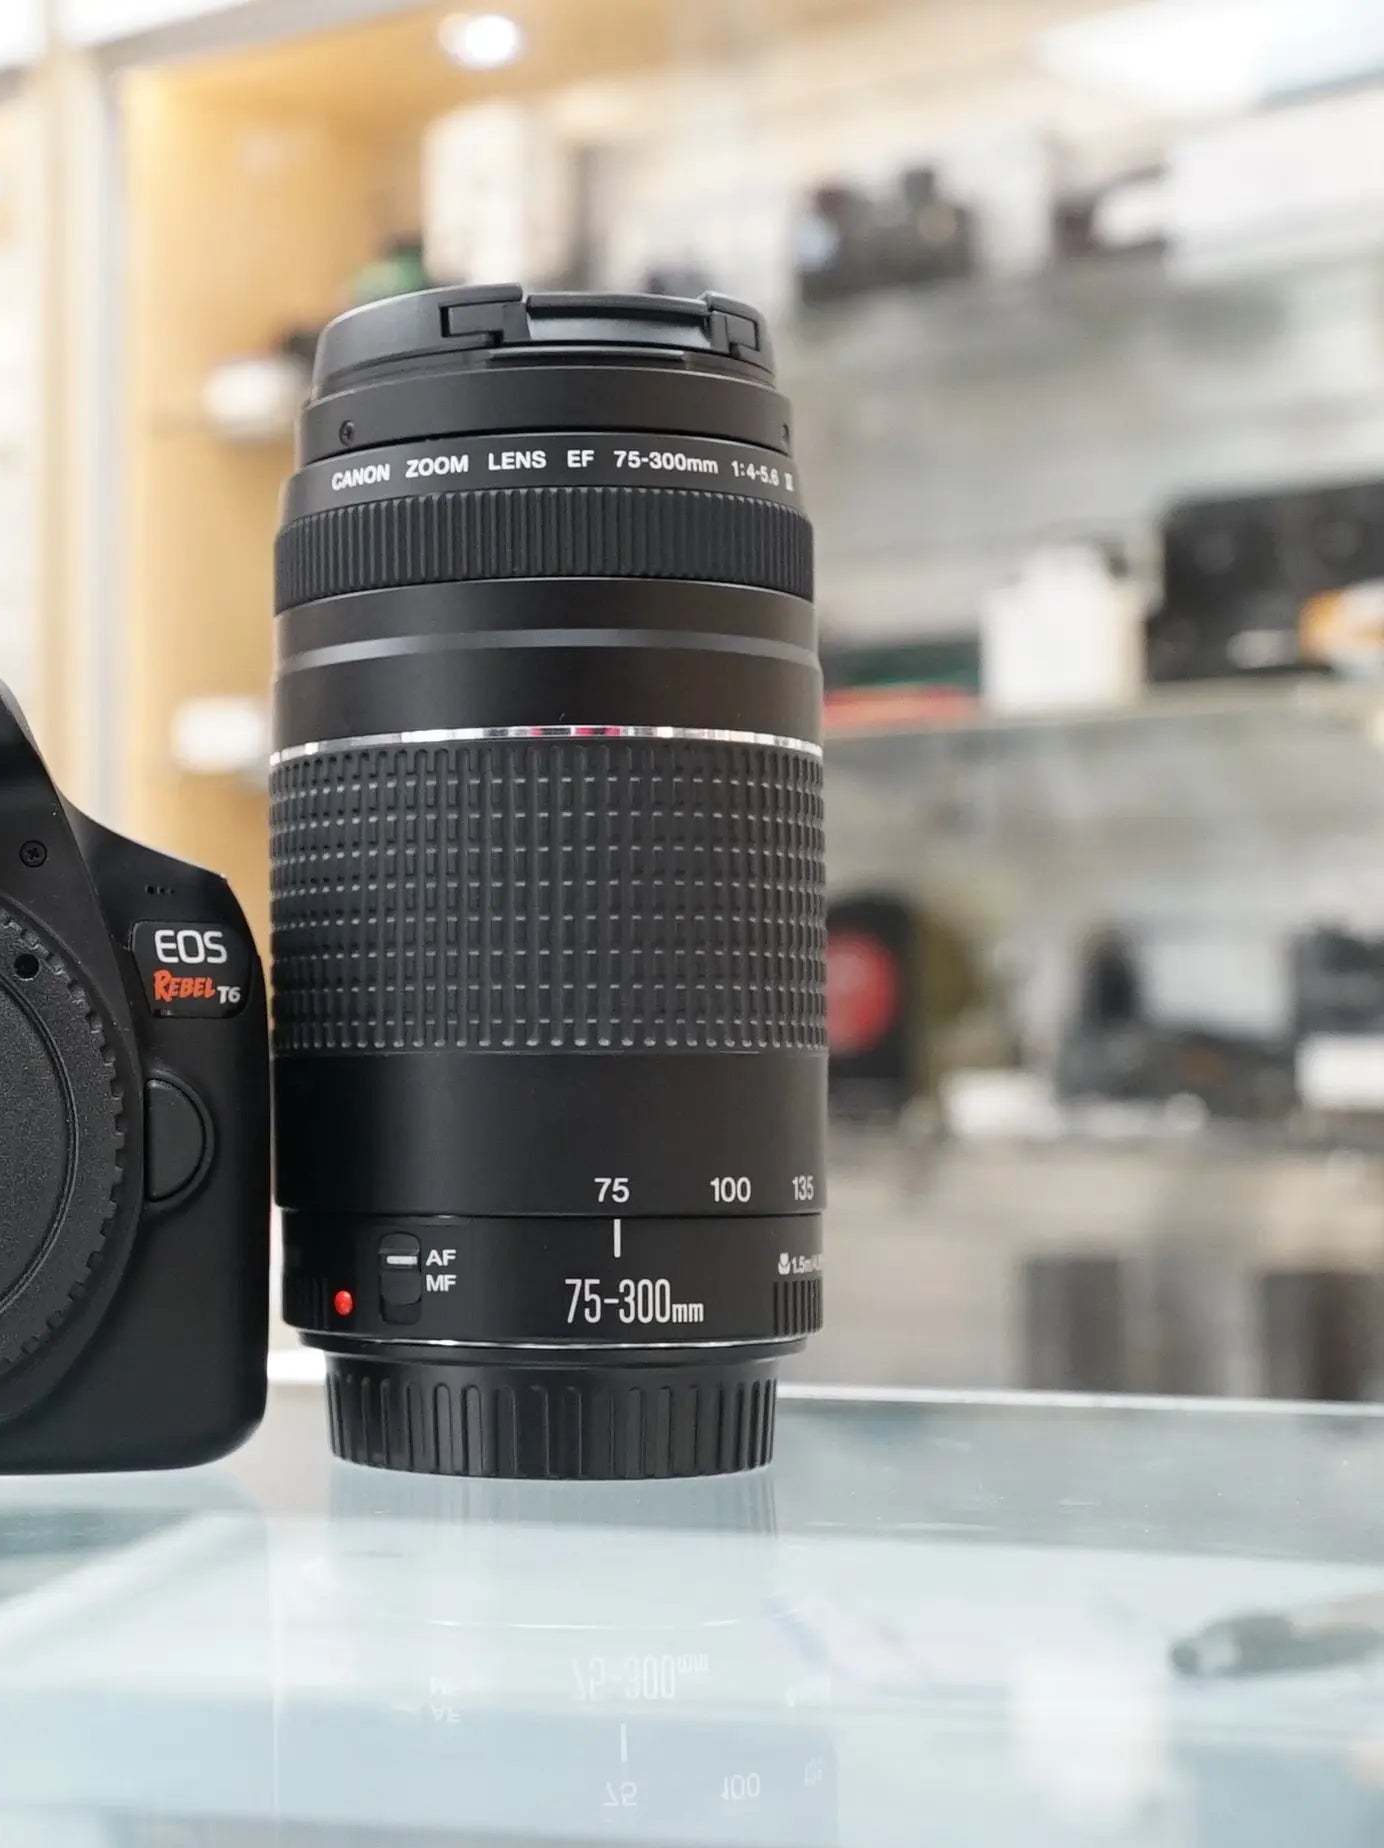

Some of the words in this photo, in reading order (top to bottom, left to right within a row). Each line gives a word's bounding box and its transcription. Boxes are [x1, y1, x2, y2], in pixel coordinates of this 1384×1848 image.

[331, 463, 391, 492] CANON
[404, 454, 470, 479] ZOOM
[488, 450, 547, 471] LENS
[567, 449, 595, 468] EF
[613, 450, 719, 475] 75-300mm
[731, 460, 780, 487] 1:4-5.6
[154, 929, 228, 964] EOS
[217, 985, 241, 1004] T6
[594, 1177, 630, 1203] 75
[710, 1176, 752, 1203] 100
[791, 1175, 815, 1201] 135
[425, 1248, 457, 1267] AF
[425, 1274, 457, 1292] MF
[564, 1278, 705, 1324] 75-300mm
